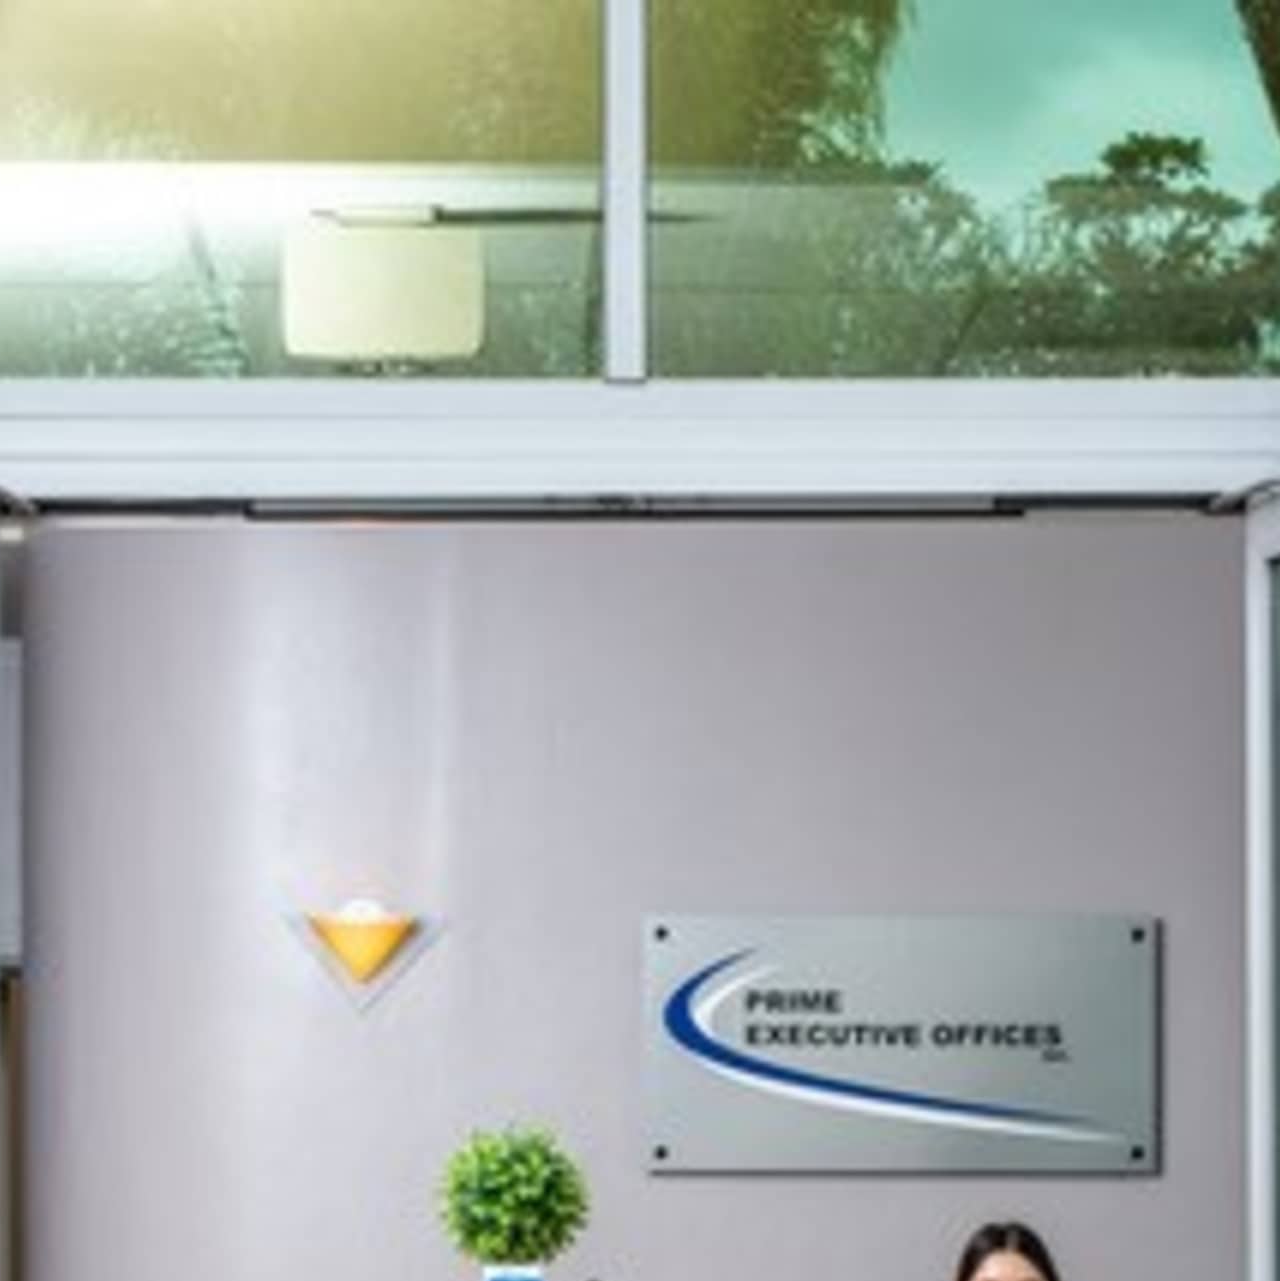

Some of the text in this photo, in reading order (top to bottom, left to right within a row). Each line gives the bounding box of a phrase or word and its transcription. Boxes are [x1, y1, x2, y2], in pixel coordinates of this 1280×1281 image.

[746, 989, 842, 1013] PRIME
[746, 1024, 1062, 1046] EXECUTIVE OFFICES
